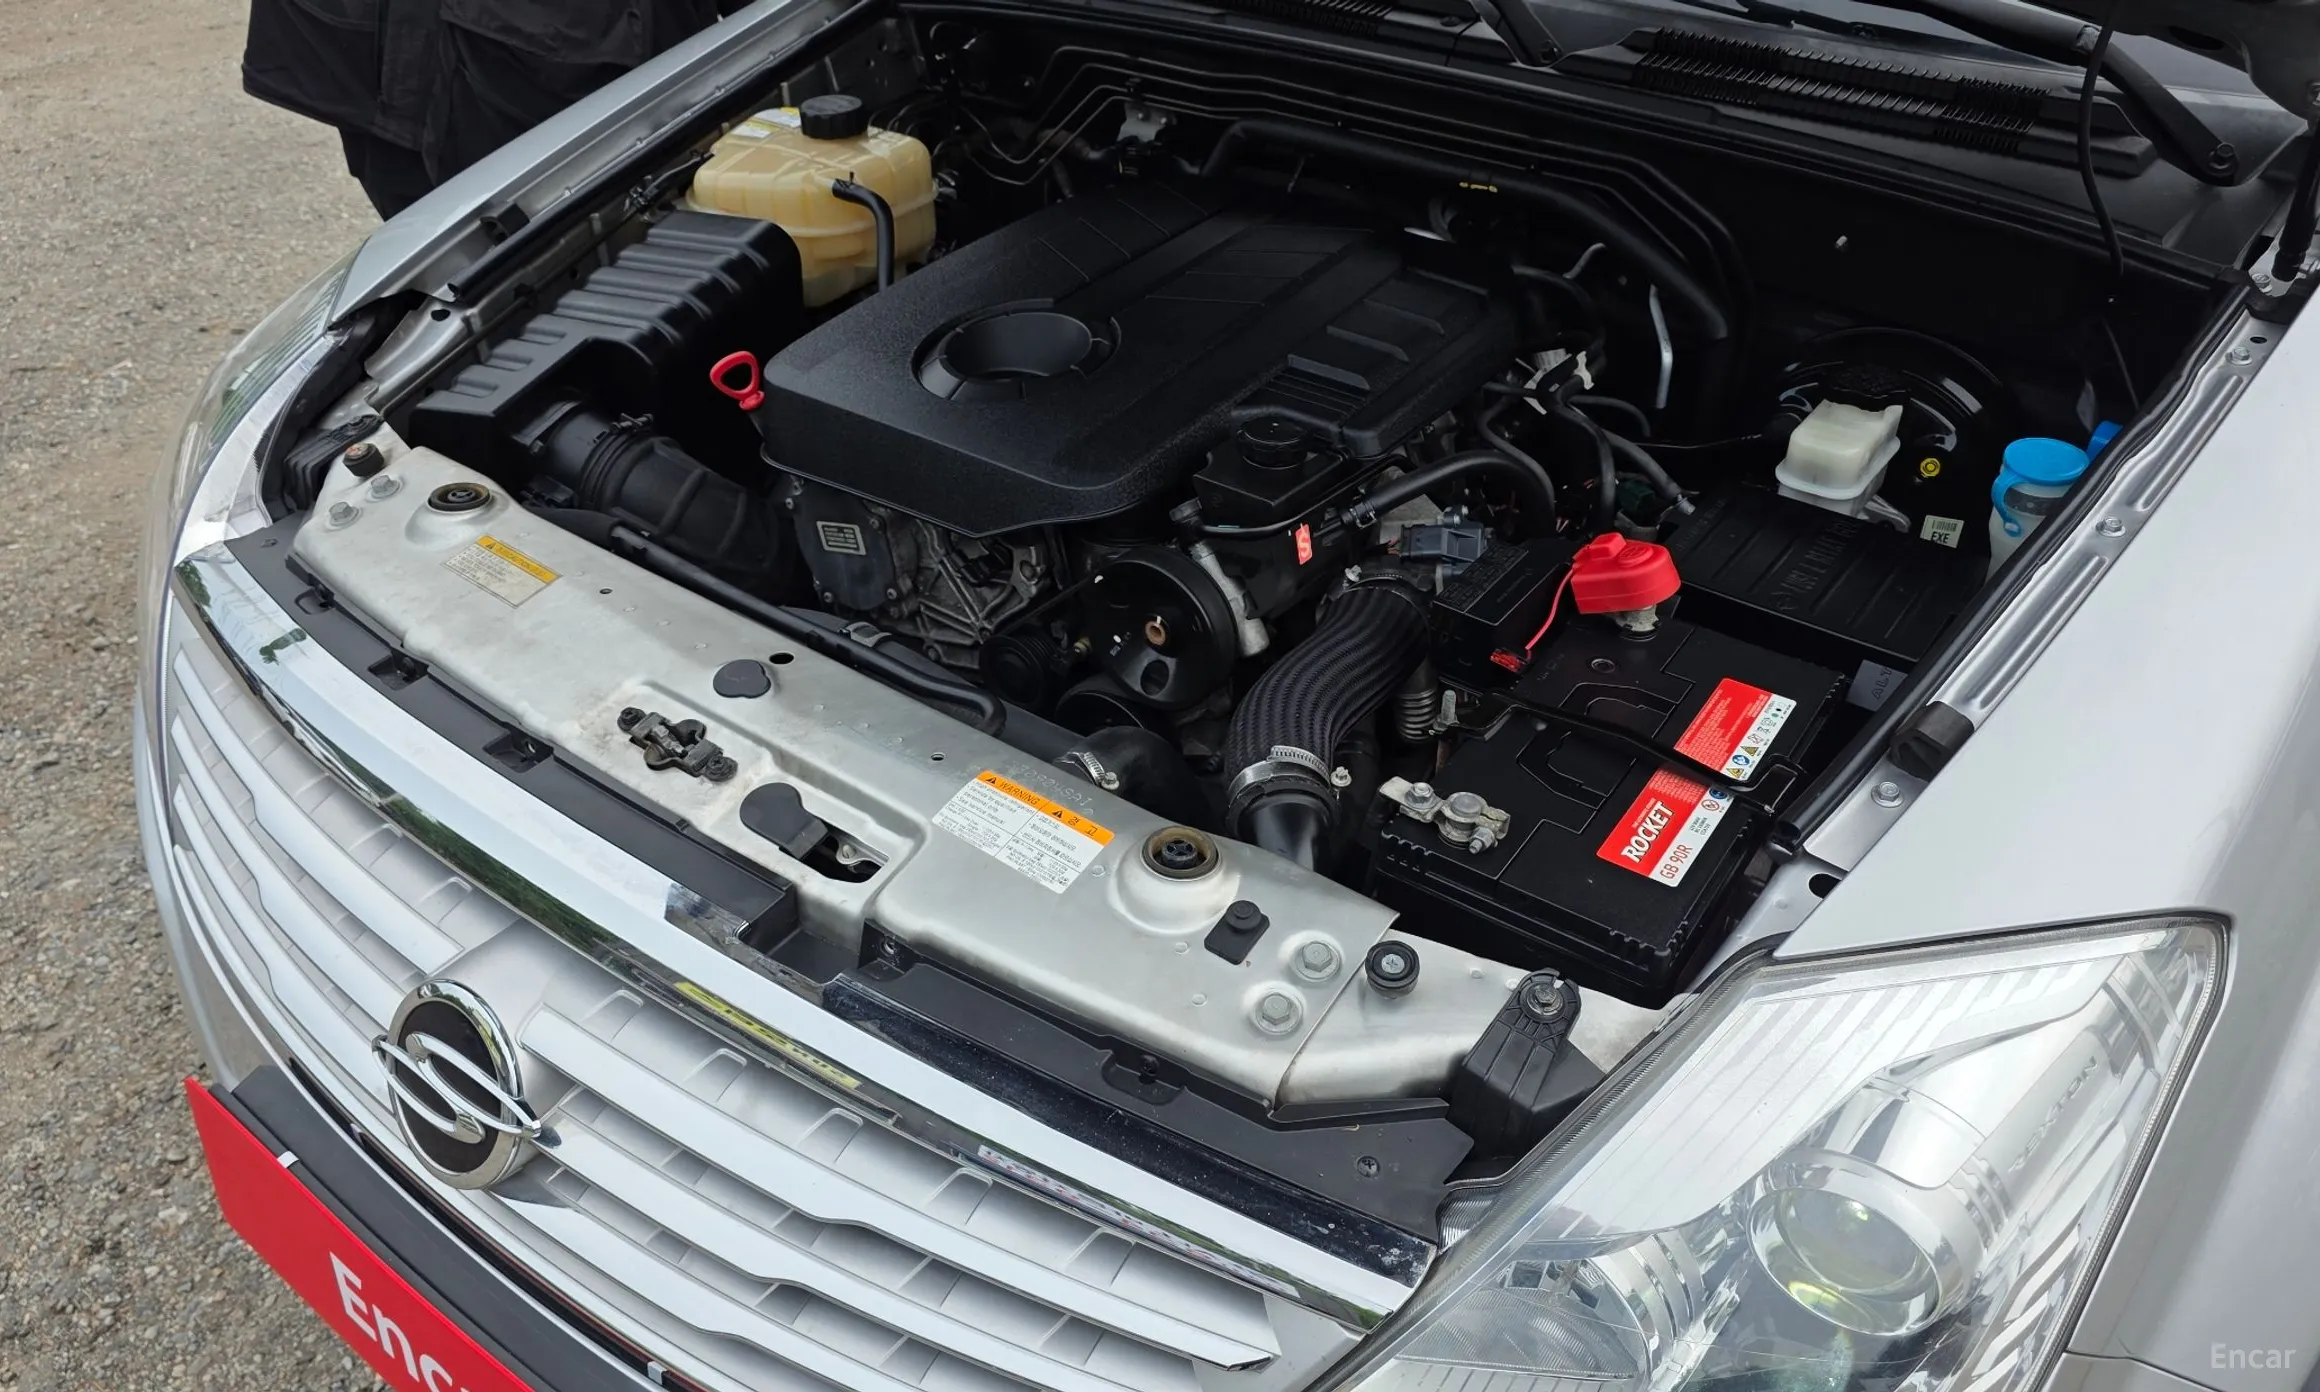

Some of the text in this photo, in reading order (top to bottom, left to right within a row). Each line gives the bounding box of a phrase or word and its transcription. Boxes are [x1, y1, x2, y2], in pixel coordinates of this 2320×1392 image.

[1000, 781, 1041, 806] WARNING
[1620, 801, 1675, 864] ROCKET
[1660, 844, 1693, 879] GB 90R
[2008, 1055, 2098, 1173] REXTON
[329, 1251, 470, 1392] Enc
